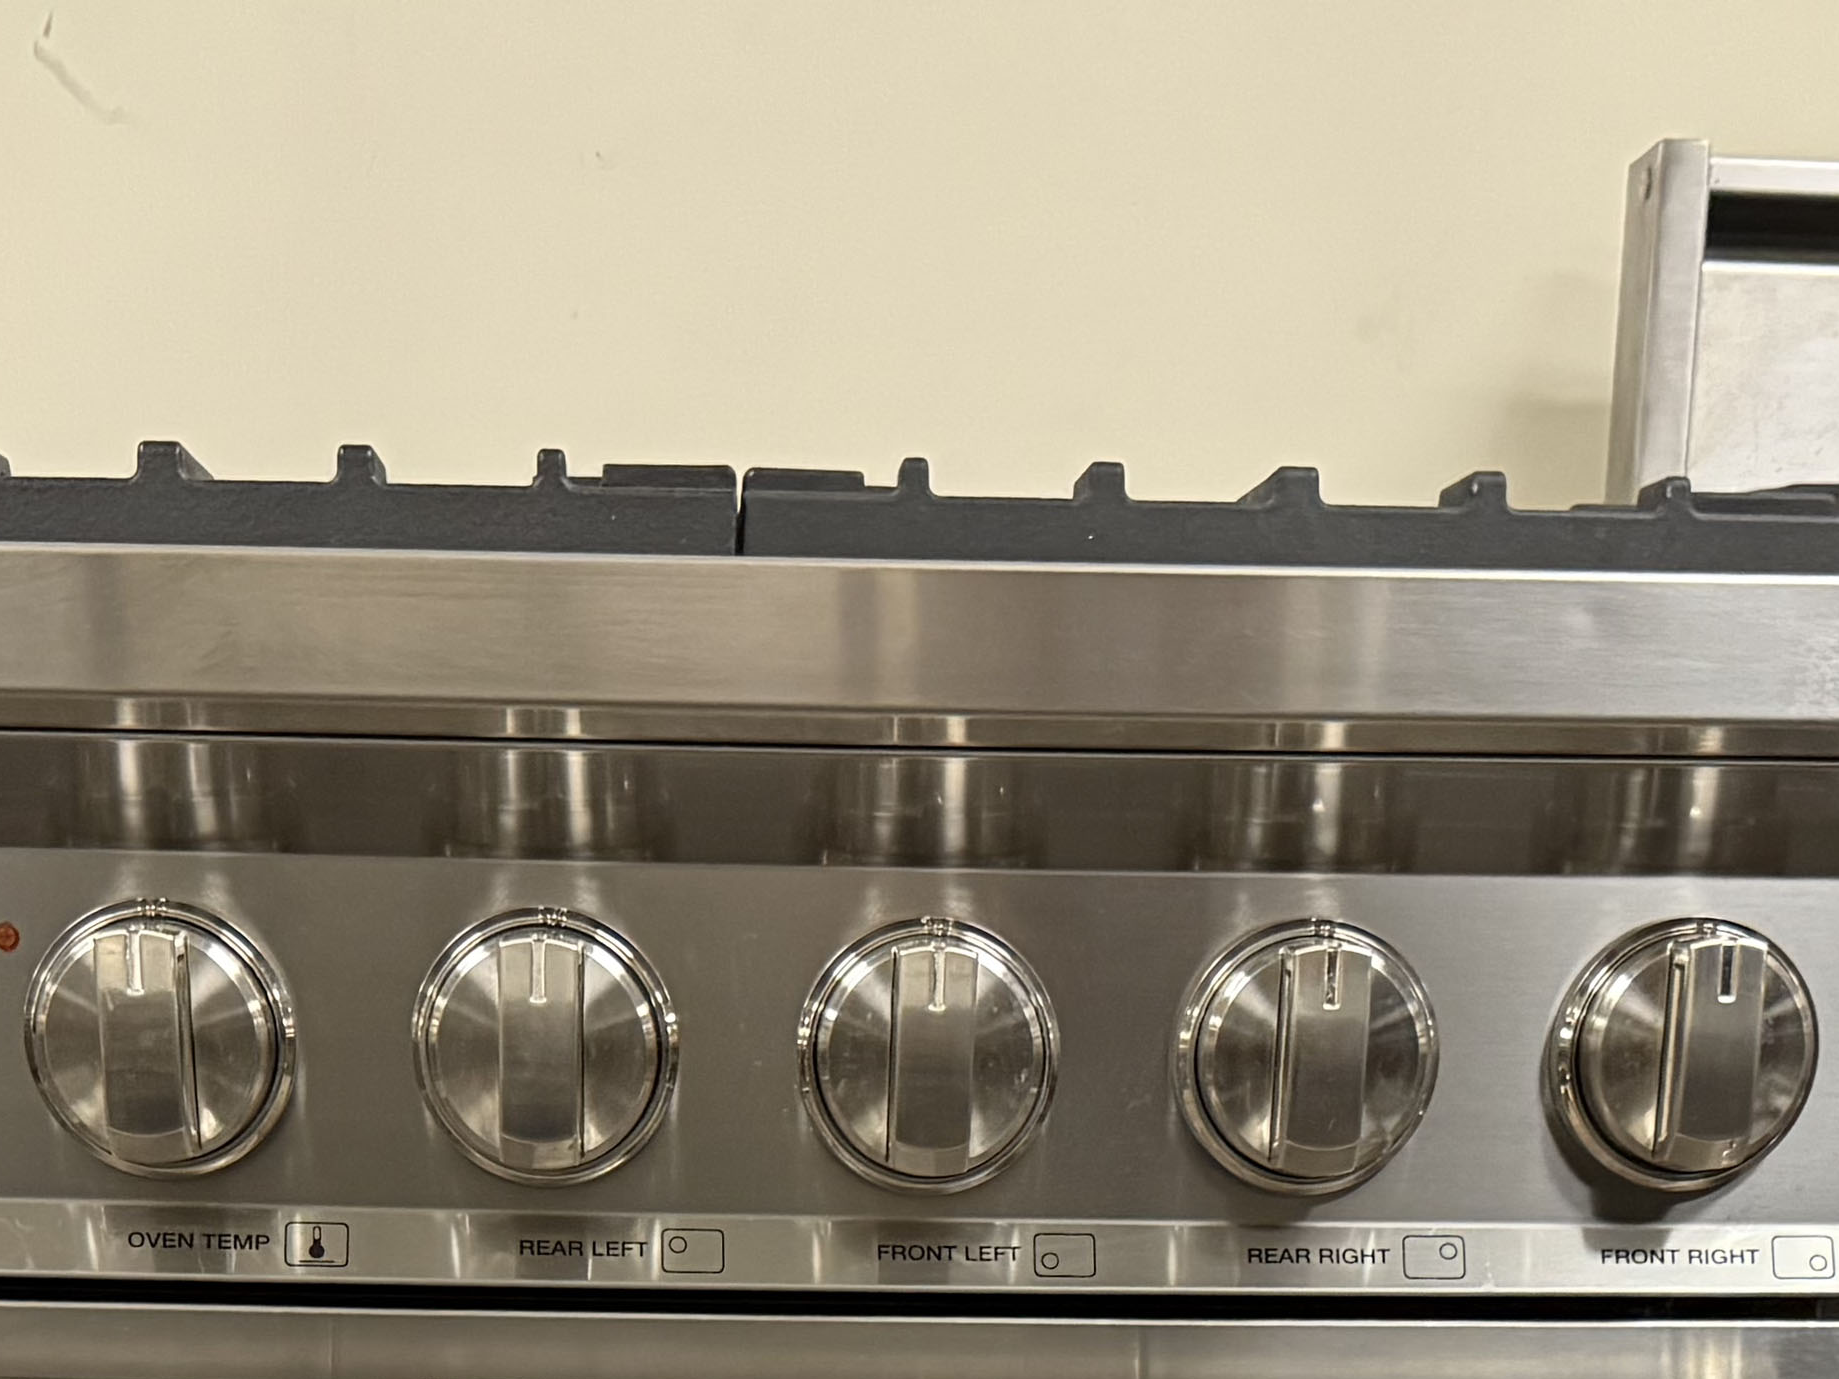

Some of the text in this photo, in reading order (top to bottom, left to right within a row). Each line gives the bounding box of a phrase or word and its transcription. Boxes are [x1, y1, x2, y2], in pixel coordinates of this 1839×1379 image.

[127, 1231, 270, 1250] OVEN TEMP
[519, 1239, 648, 1257] REAR LEFT
[877, 1244, 1022, 1262] FRONT LEFT
[1247, 1248, 1391, 1265] REAR RIGHT
[1600, 1249, 1761, 1265] FRONT RIGHT
